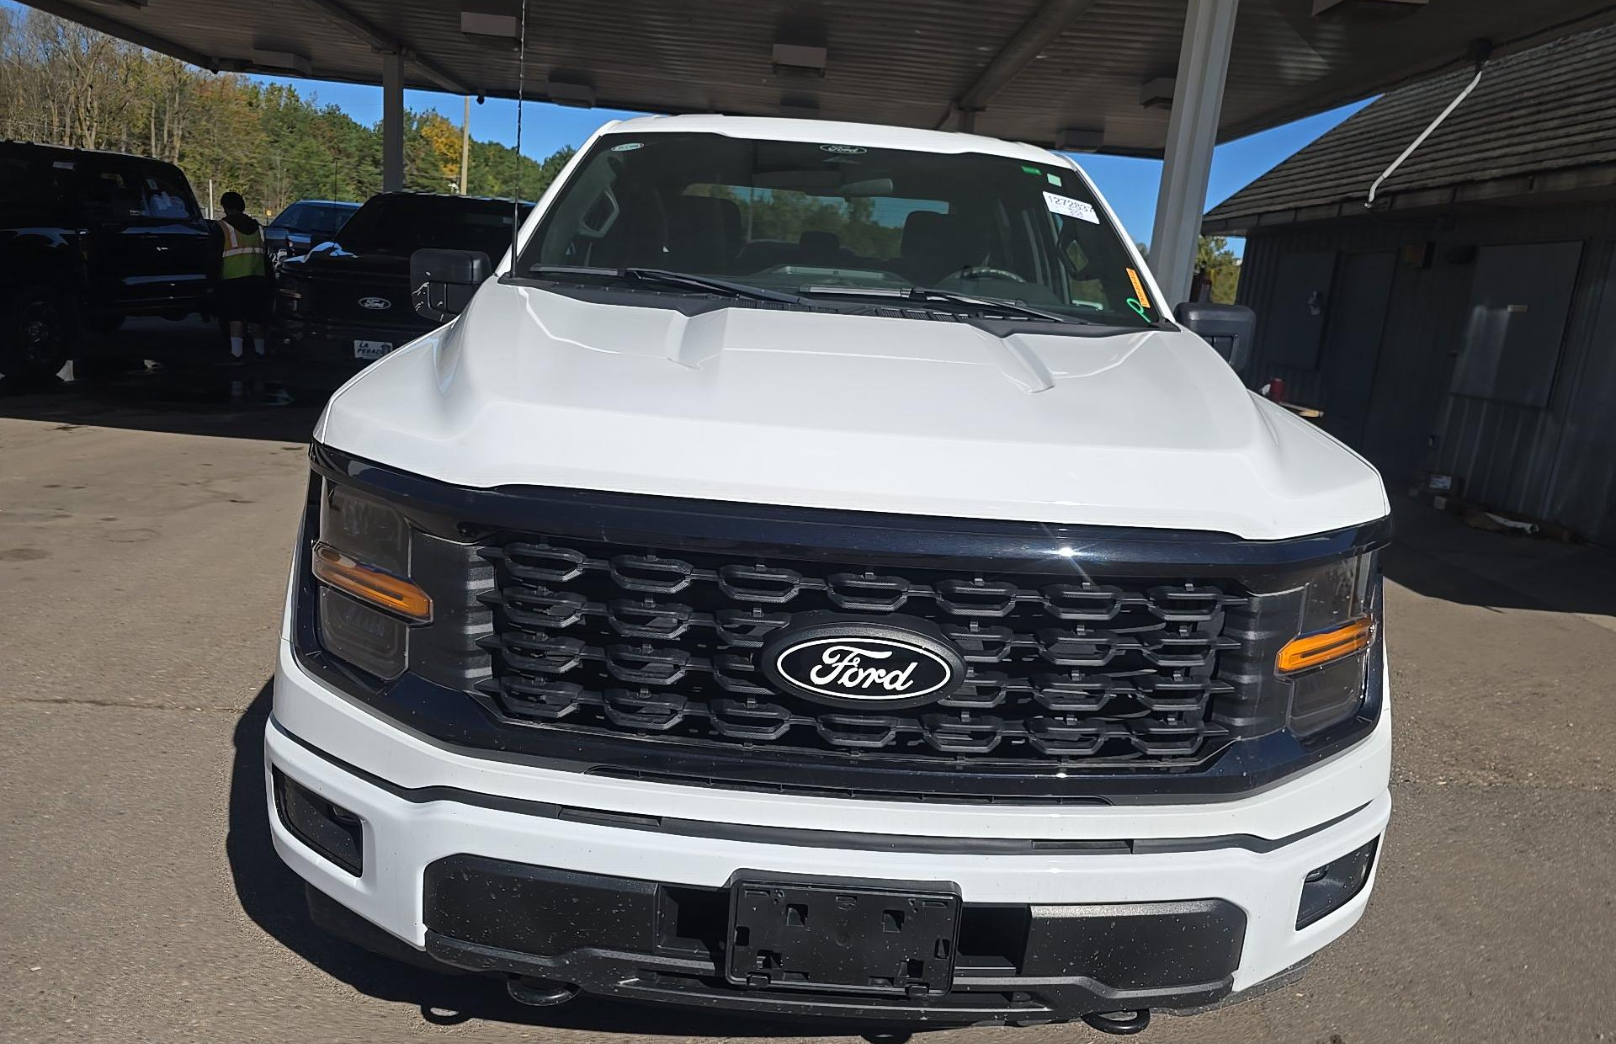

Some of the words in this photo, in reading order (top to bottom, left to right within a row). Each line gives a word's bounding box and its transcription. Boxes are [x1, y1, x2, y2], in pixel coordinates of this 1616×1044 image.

[828, 145, 859, 154] Ford
[364, 299, 385, 307] Ford
[810, 645, 918, 691] Ford
